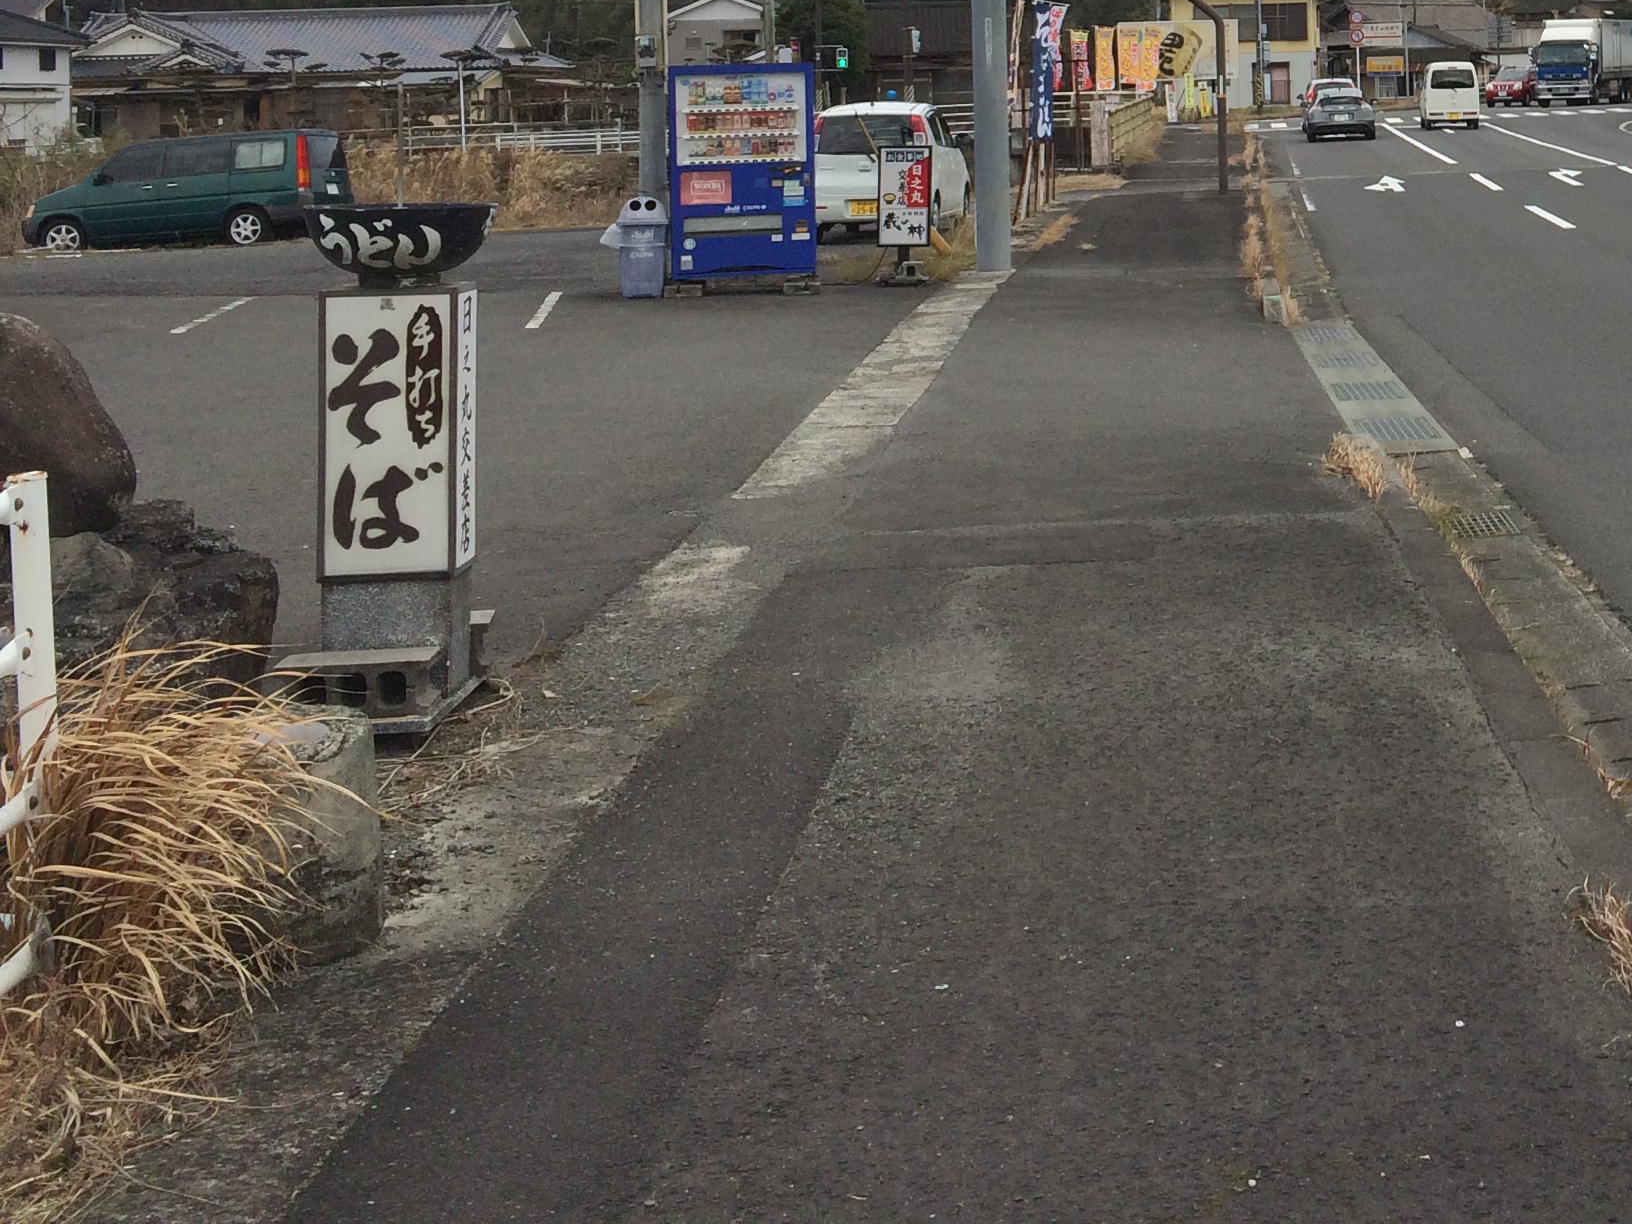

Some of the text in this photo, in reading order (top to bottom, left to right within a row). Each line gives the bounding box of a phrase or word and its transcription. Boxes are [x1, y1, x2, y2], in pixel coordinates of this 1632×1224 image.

[692, 181, 724, 192] WONDA
[911, 164, 925, 204] 日之丸
[319, 213, 442, 270] うどん
[408, 313, 441, 440] 手打ち
[327, 327, 444, 550] そば
